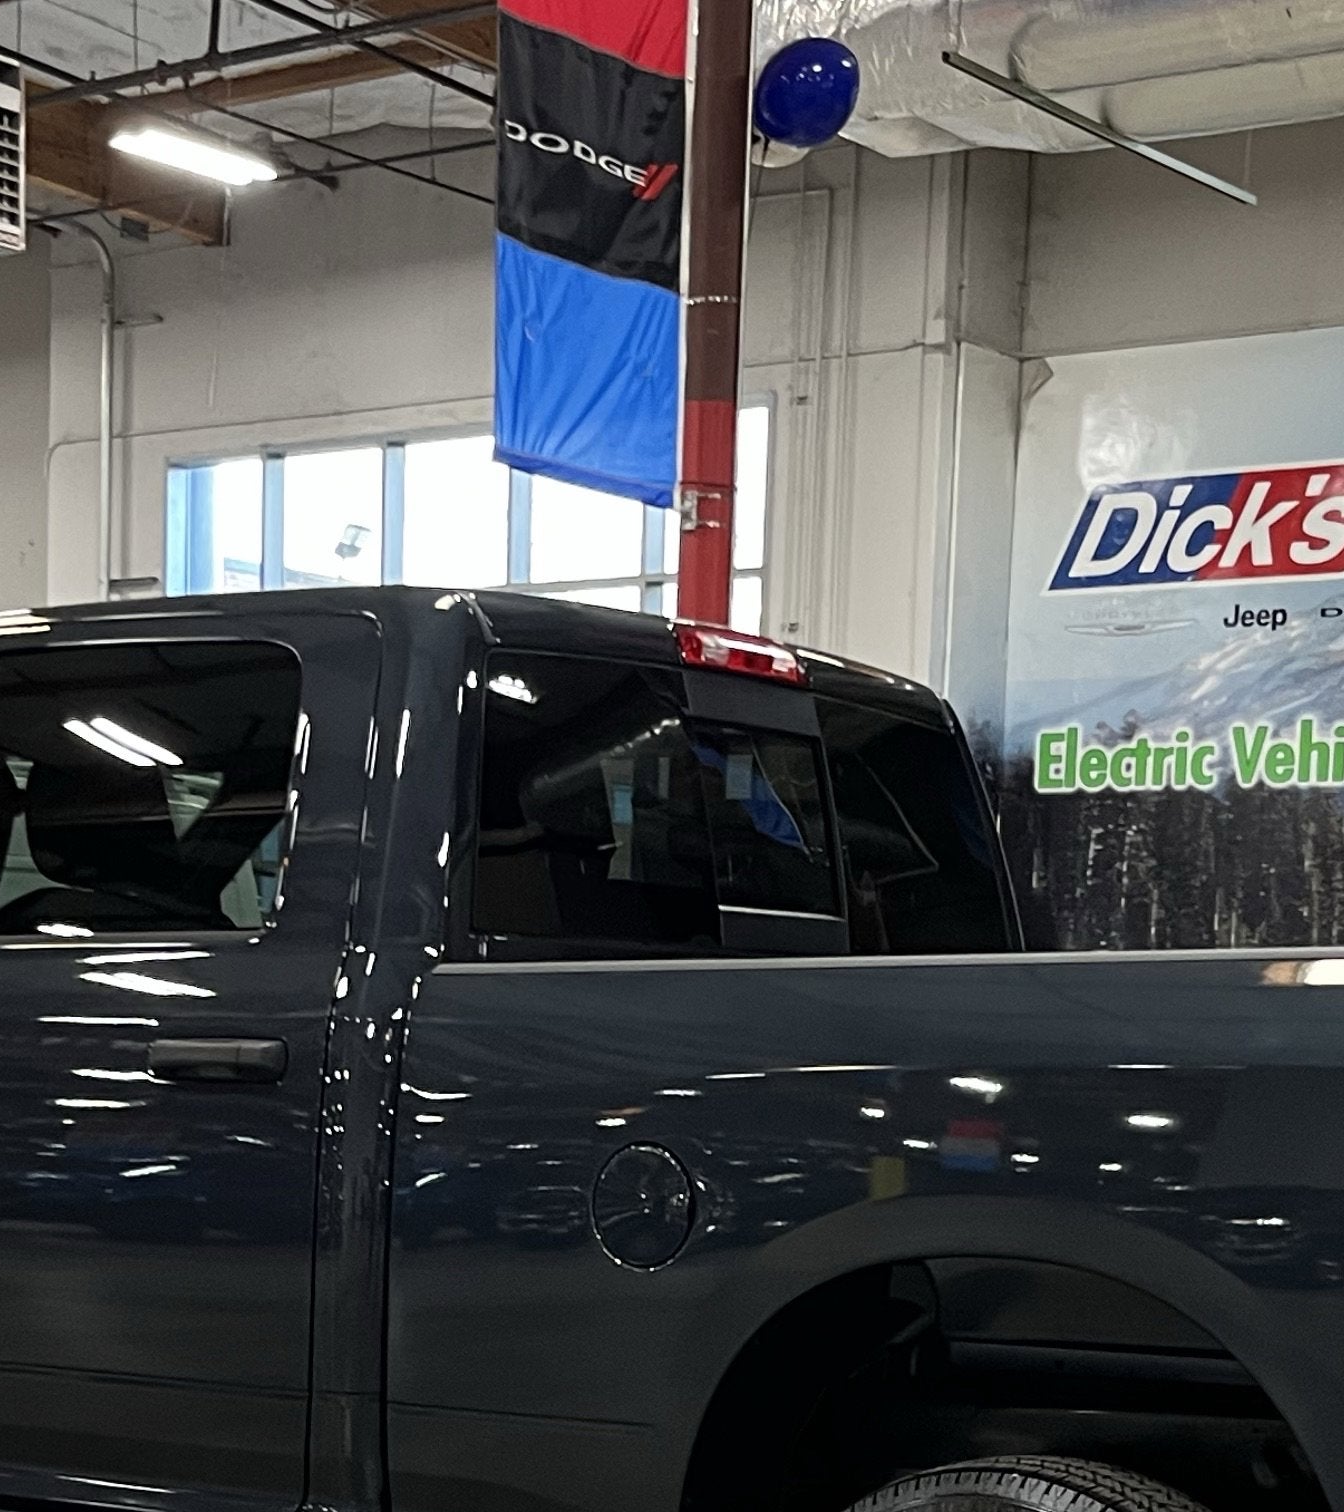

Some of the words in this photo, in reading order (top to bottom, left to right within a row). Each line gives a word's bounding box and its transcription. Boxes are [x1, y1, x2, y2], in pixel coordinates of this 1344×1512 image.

[504, 119, 649, 188] DODGE
[1223, 604, 1287, 631] Jeep
[1037, 727, 1216, 789] Electric
